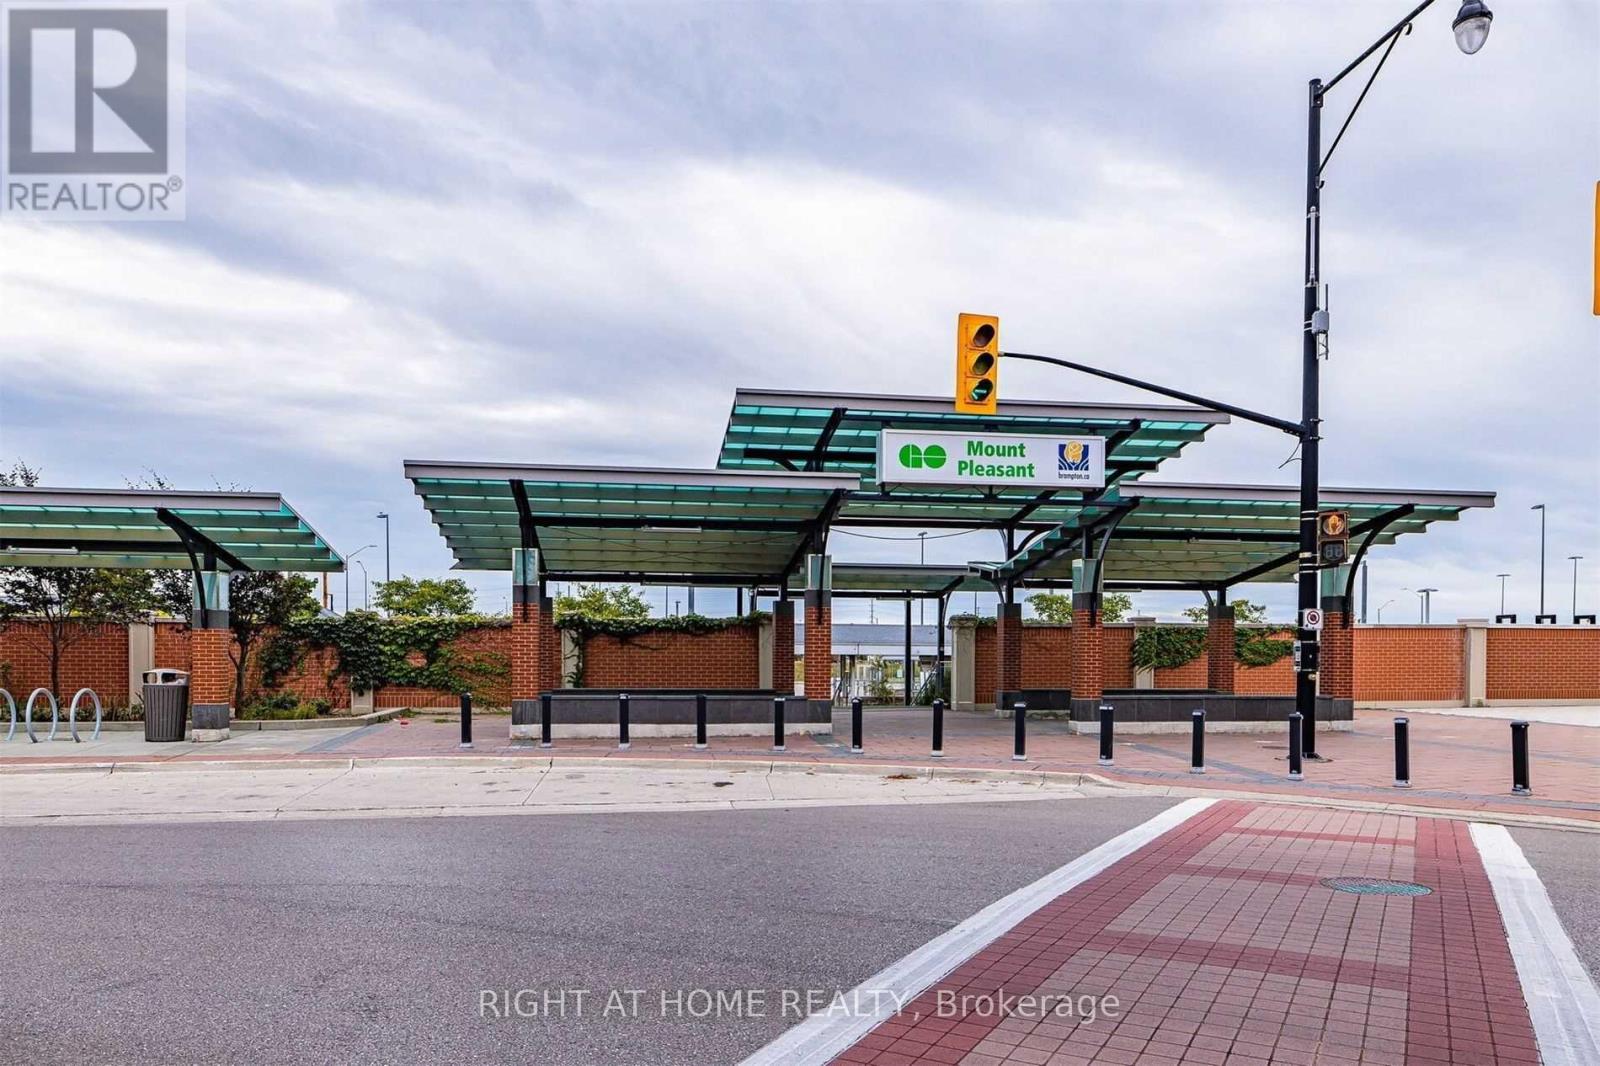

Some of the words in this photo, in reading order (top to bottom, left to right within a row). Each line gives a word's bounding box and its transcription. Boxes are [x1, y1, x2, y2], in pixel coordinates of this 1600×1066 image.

[899, 444, 947, 469] GO
[967, 440, 1026, 458] Mount
[958, 460, 1035, 478] Pleasant
[1058, 471, 1090, 480] brampton.ca
